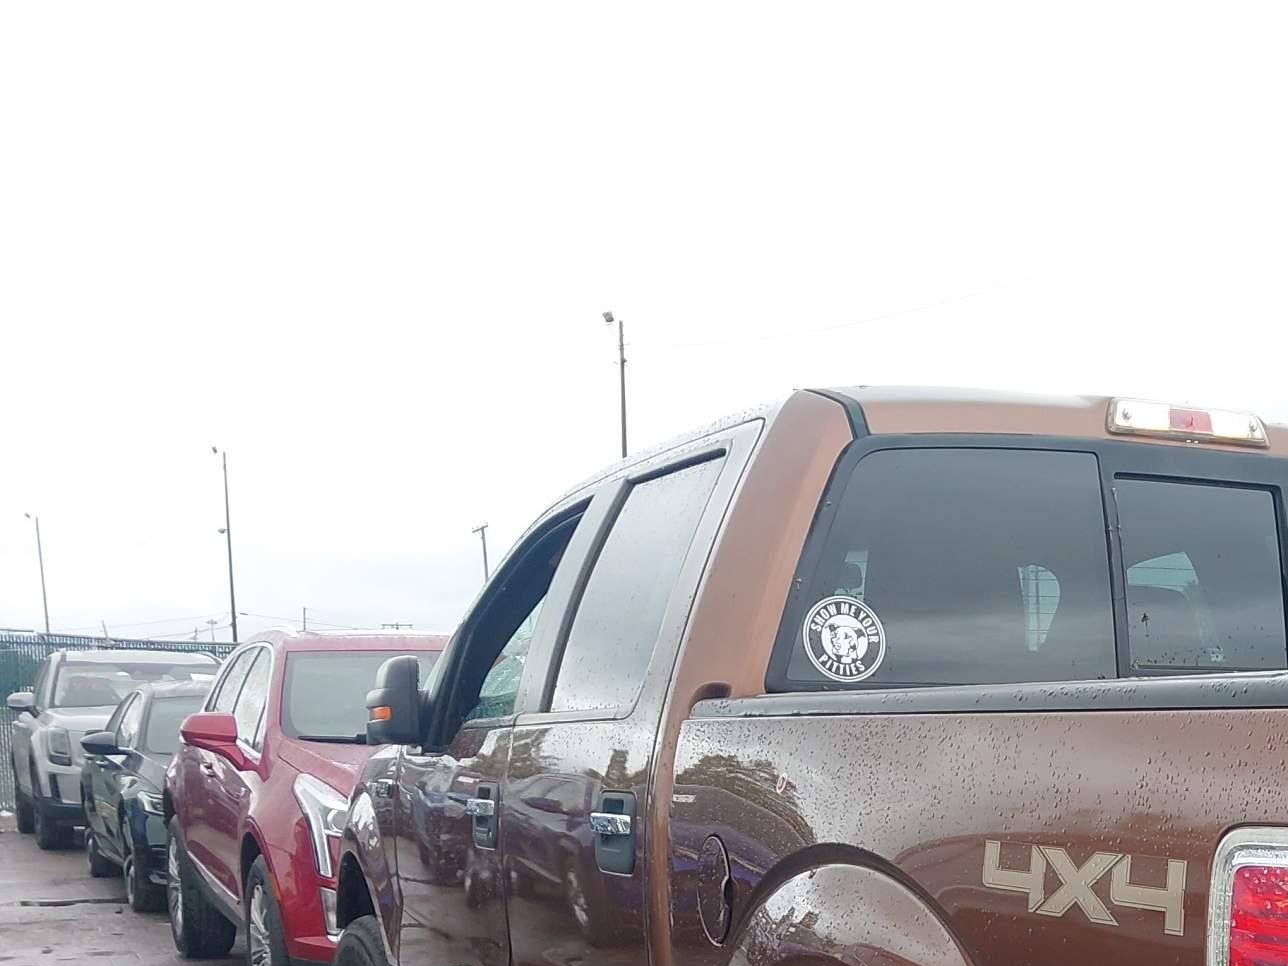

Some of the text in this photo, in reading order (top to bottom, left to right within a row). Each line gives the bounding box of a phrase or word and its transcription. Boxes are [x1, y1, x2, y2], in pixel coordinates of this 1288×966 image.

[811, 603, 880, 643] SHOW ME YOUR
[819, 654, 866, 676] PITTIES
[982, 839, 1188, 937] 4X4
